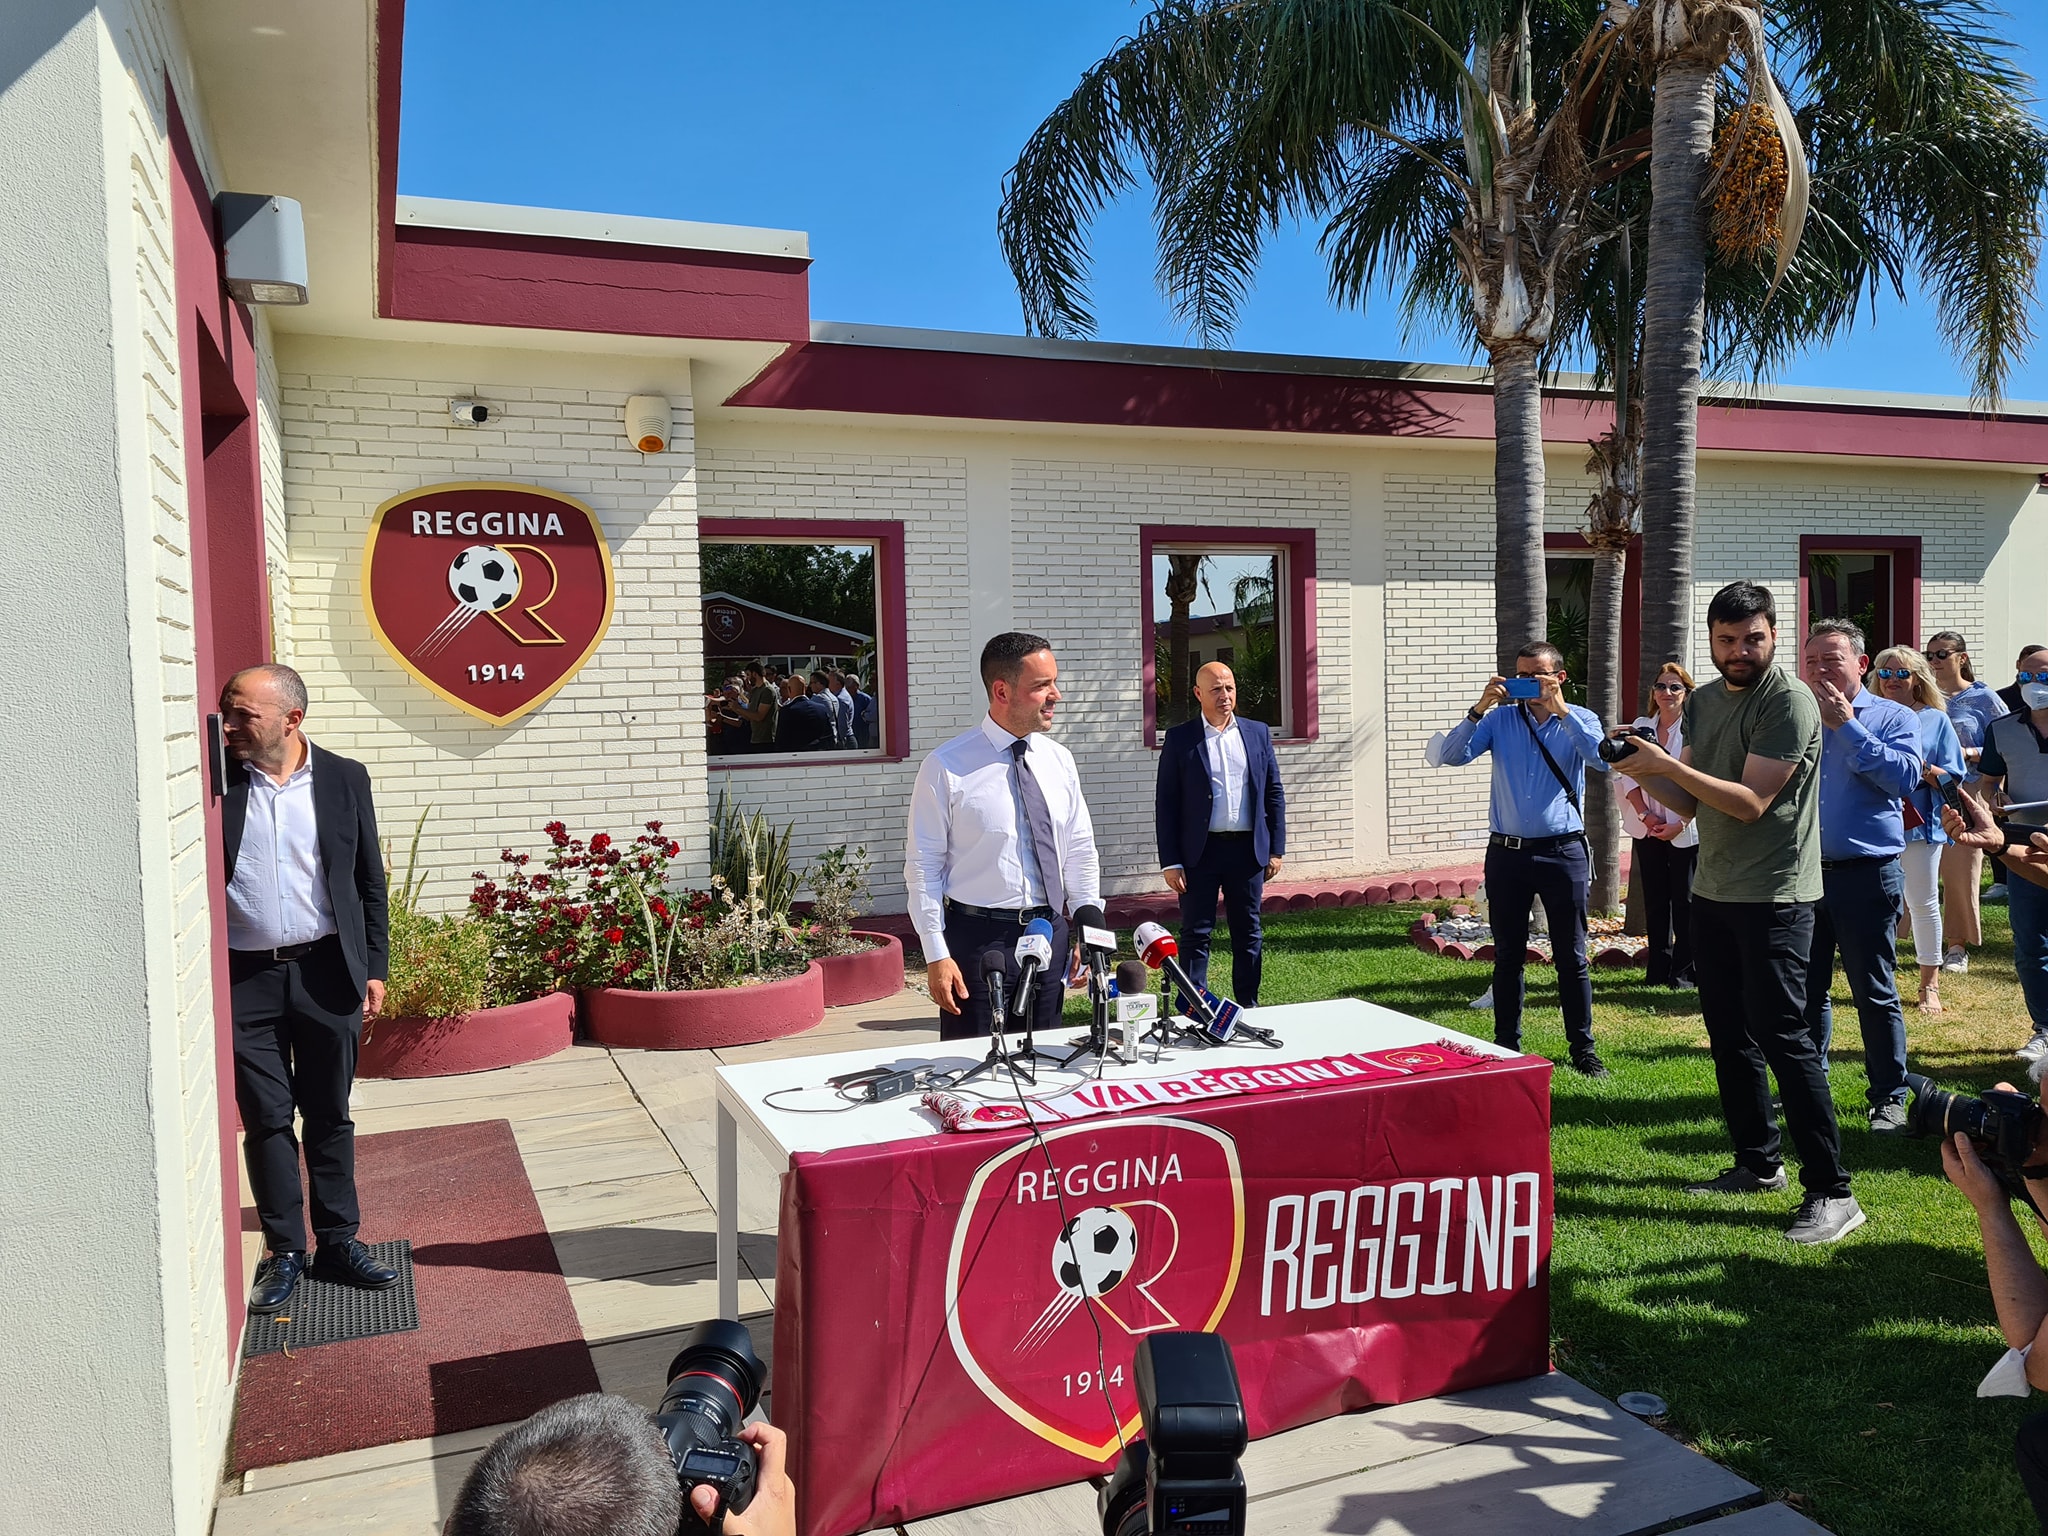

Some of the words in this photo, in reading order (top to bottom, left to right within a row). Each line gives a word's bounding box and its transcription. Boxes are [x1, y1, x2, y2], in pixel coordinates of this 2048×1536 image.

[411, 510, 565, 536] REGGINA
[467, 663, 525, 682] 1914
[1158, 1060, 1369, 1098] REGGINA
[1017, 1152, 1184, 1205] REGGINA
[1261, 1171, 1541, 1317] REGGINA
[1062, 1364, 1125, 1398] 1914
